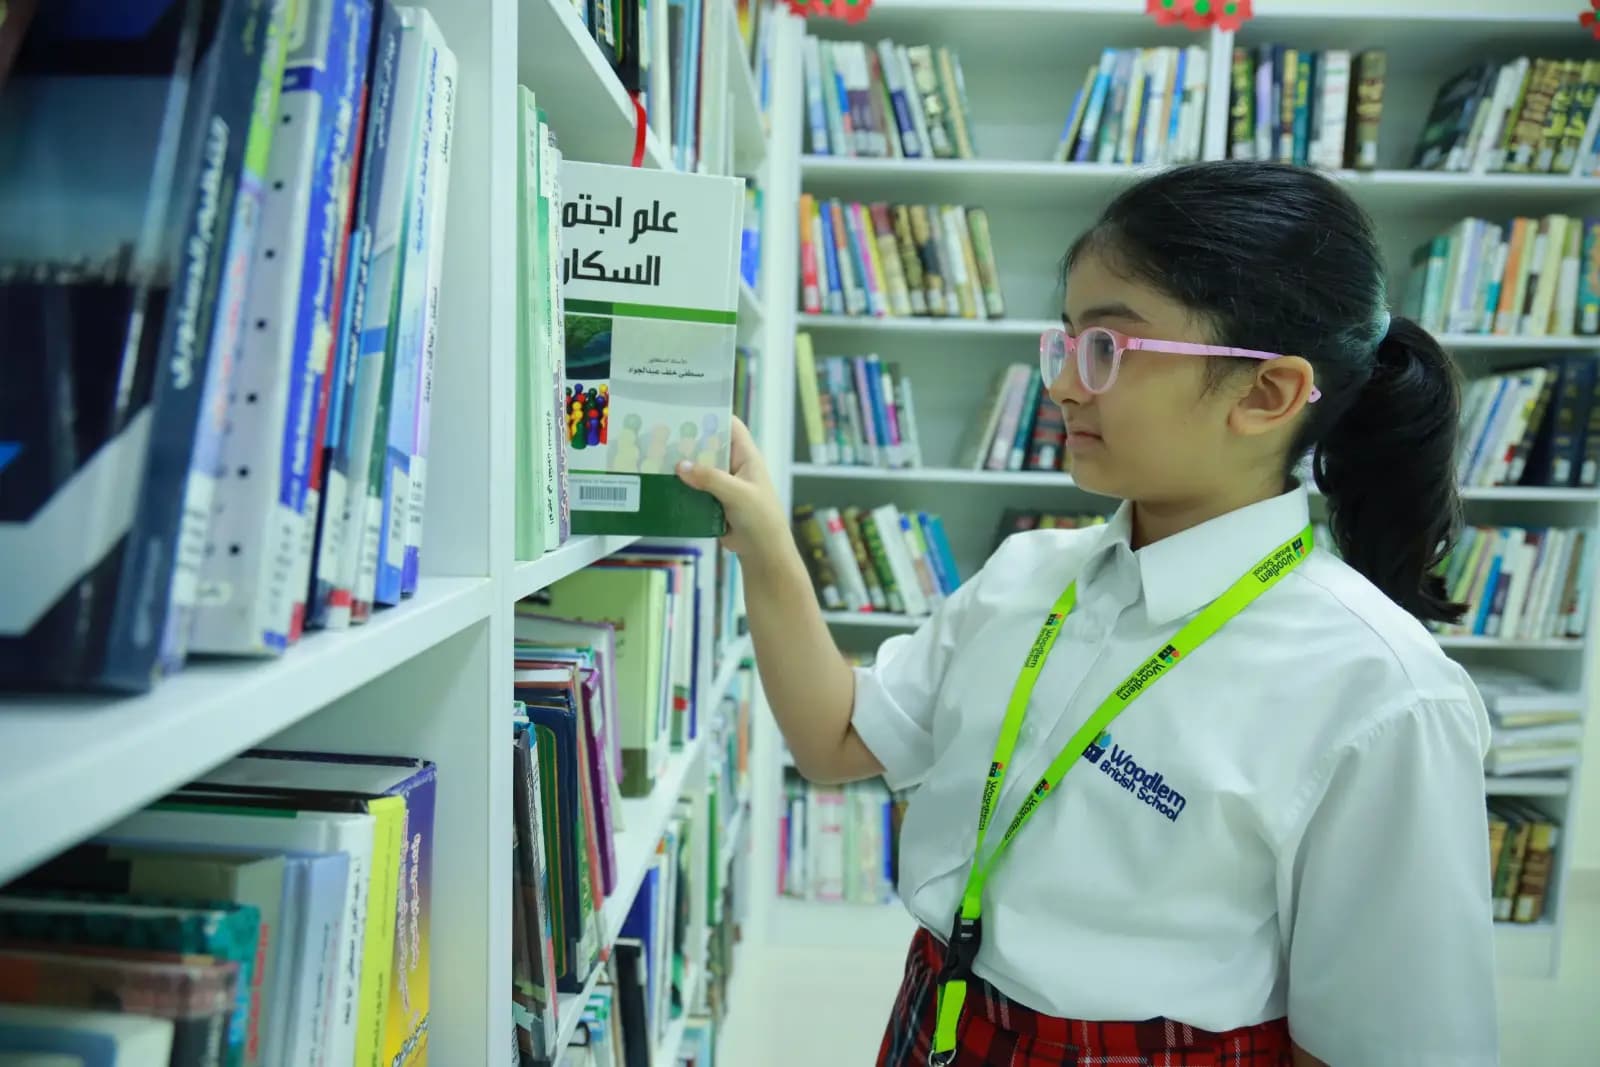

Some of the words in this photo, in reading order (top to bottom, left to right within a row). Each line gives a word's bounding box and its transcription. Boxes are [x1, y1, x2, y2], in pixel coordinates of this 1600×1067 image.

[562, 193, 622, 235] اجتم
[628, 200, 678, 244] علم
[1257, 552, 1296, 583] Woodlem
[1120, 663, 1167, 701] Woodlem
[1099, 759, 1136, 793] British
[1137, 786, 1180, 822] School
[1110, 743, 1187, 812] Woodlem
